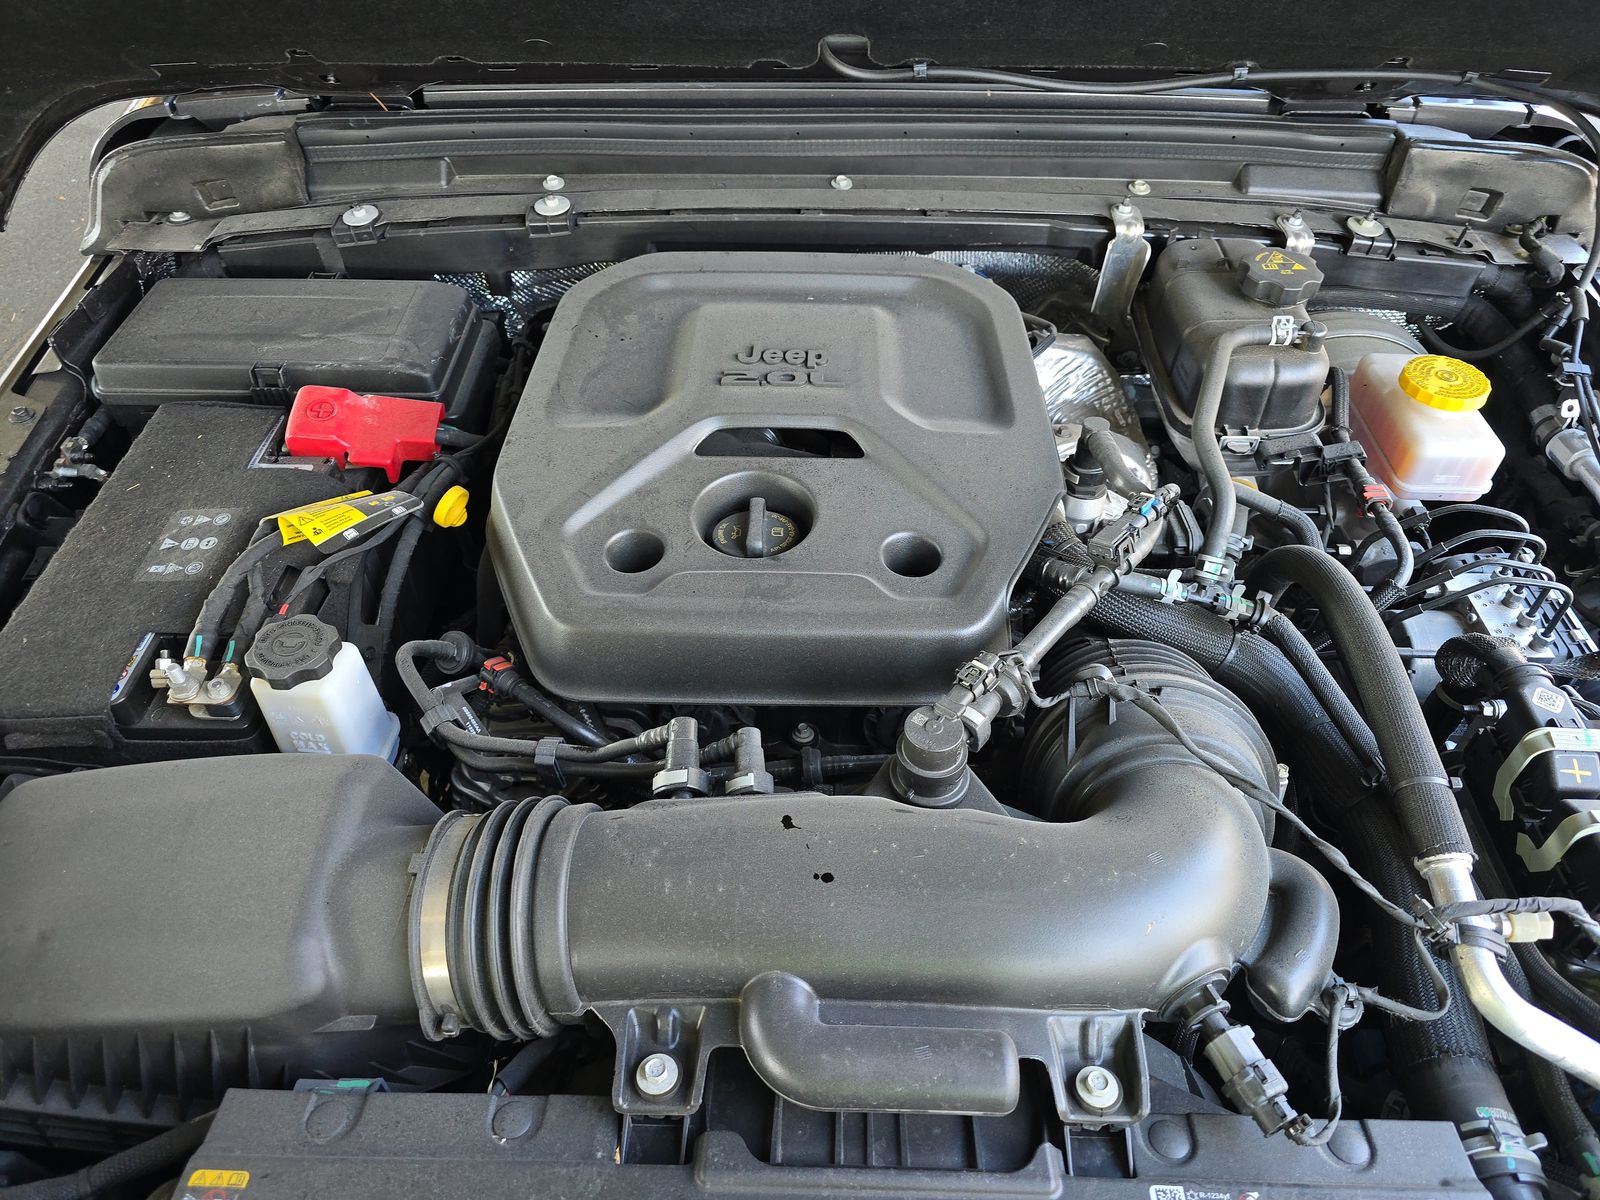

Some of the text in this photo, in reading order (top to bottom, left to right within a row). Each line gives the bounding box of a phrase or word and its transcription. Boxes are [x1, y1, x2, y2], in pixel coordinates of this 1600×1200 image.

[735, 344, 829, 369] Jeep
[719, 370, 846, 388] 2.0L
[289, 731, 325, 741] COLD
